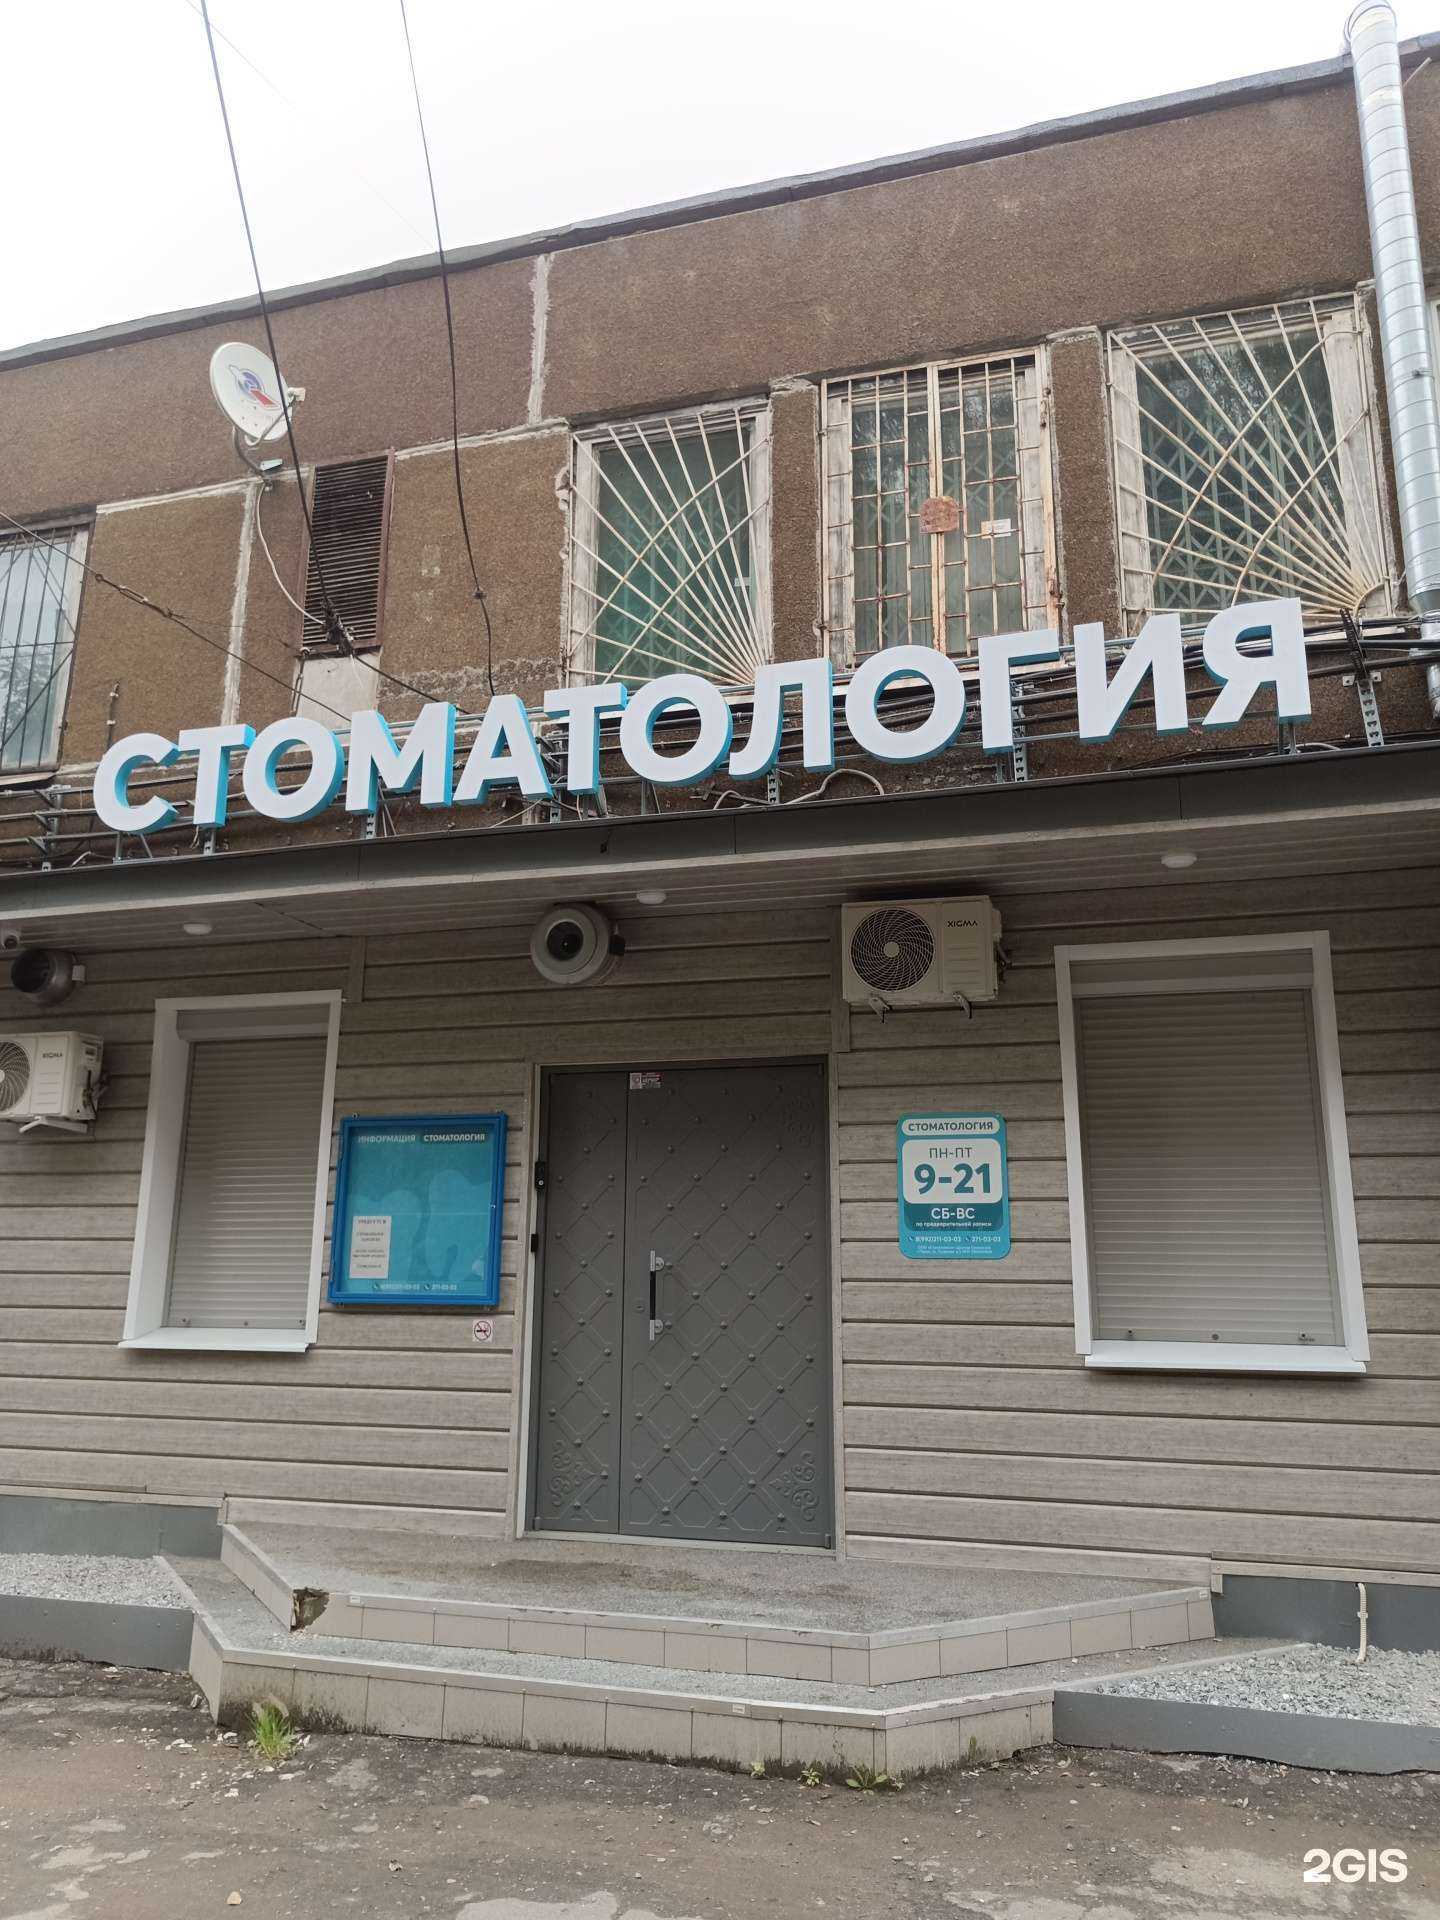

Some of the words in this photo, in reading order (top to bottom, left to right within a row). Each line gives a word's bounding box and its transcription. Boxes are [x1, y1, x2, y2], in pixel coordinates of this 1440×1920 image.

[93, 596, 1312, 833] СТОМАТОЛОГИЯ
[947, 920, 978, 928] XIGMA
[908, 1121, 993, 1131] СТОМАТОЛОГИЯ
[358, 1134, 415, 1143] ИНФОРМАЦИЯ
[423, 1133, 485, 1142] СТОМАТОЛОГИЯ
[929, 1147, 972, 1158] ПН-ПТ
[914, 1163, 990, 1194] 9-21
[931, 1207, 975, 1219] СБ-ВС
